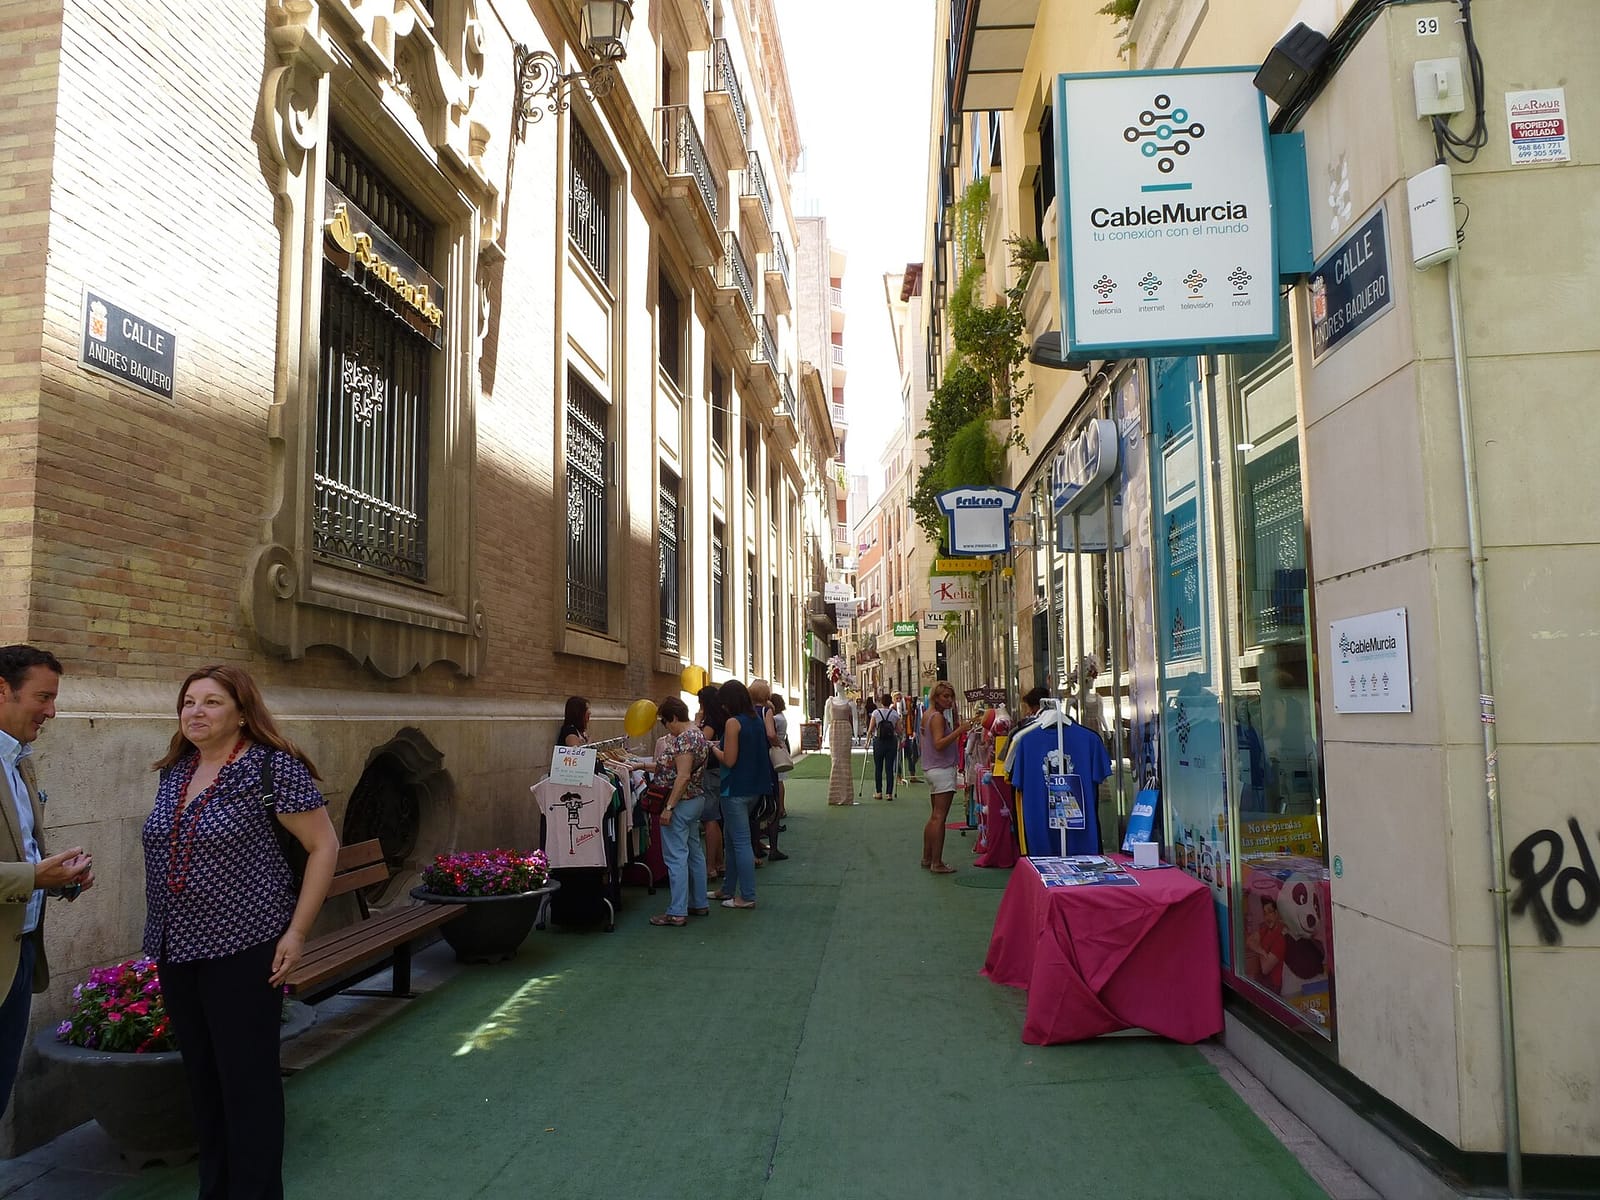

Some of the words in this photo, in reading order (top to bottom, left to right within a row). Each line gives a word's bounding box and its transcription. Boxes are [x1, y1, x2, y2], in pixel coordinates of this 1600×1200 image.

[1417, 19, 1438, 34] 39
[1515, 120, 1559, 130] PROPIEDAD
[1519, 128, 1557, 137] VIGILADA
[1091, 201, 1248, 228] CableMurcia
[1093, 231, 1105, 242] tu
[1108, 228, 1163, 240] conexión
[1166, 228, 1189, 238] con
[1192, 226, 1203, 236] el
[1206, 223, 1249, 235] mundo
[1334, 230, 1374, 285] CALLE
[1138, 304, 1165, 312] internet
[1180, 301, 1214, 310] televisión
[1313, 309, 1345, 347] ANDRES
[1346, 274, 1386, 323] BAQUERO
[122, 318, 165, 355] CALLE
[88, 341, 128, 371] ANDRES
[130, 359, 171, 391] BAQUERO
[934, 583, 976, 601] Kelia
[1349, 635, 1397, 654] CableMurcia
[986, 692, 1006, 700] -50%
[558, 747, 586, 757] Desde
[1248, 824, 1260, 833] No
[1262, 824, 1270, 832] te
[1271, 820, 1302, 833] pierdas
[1241, 838, 1254, 847] las
[1256, 835, 1288, 847] mejores
[1289, 832, 1312, 841] series
